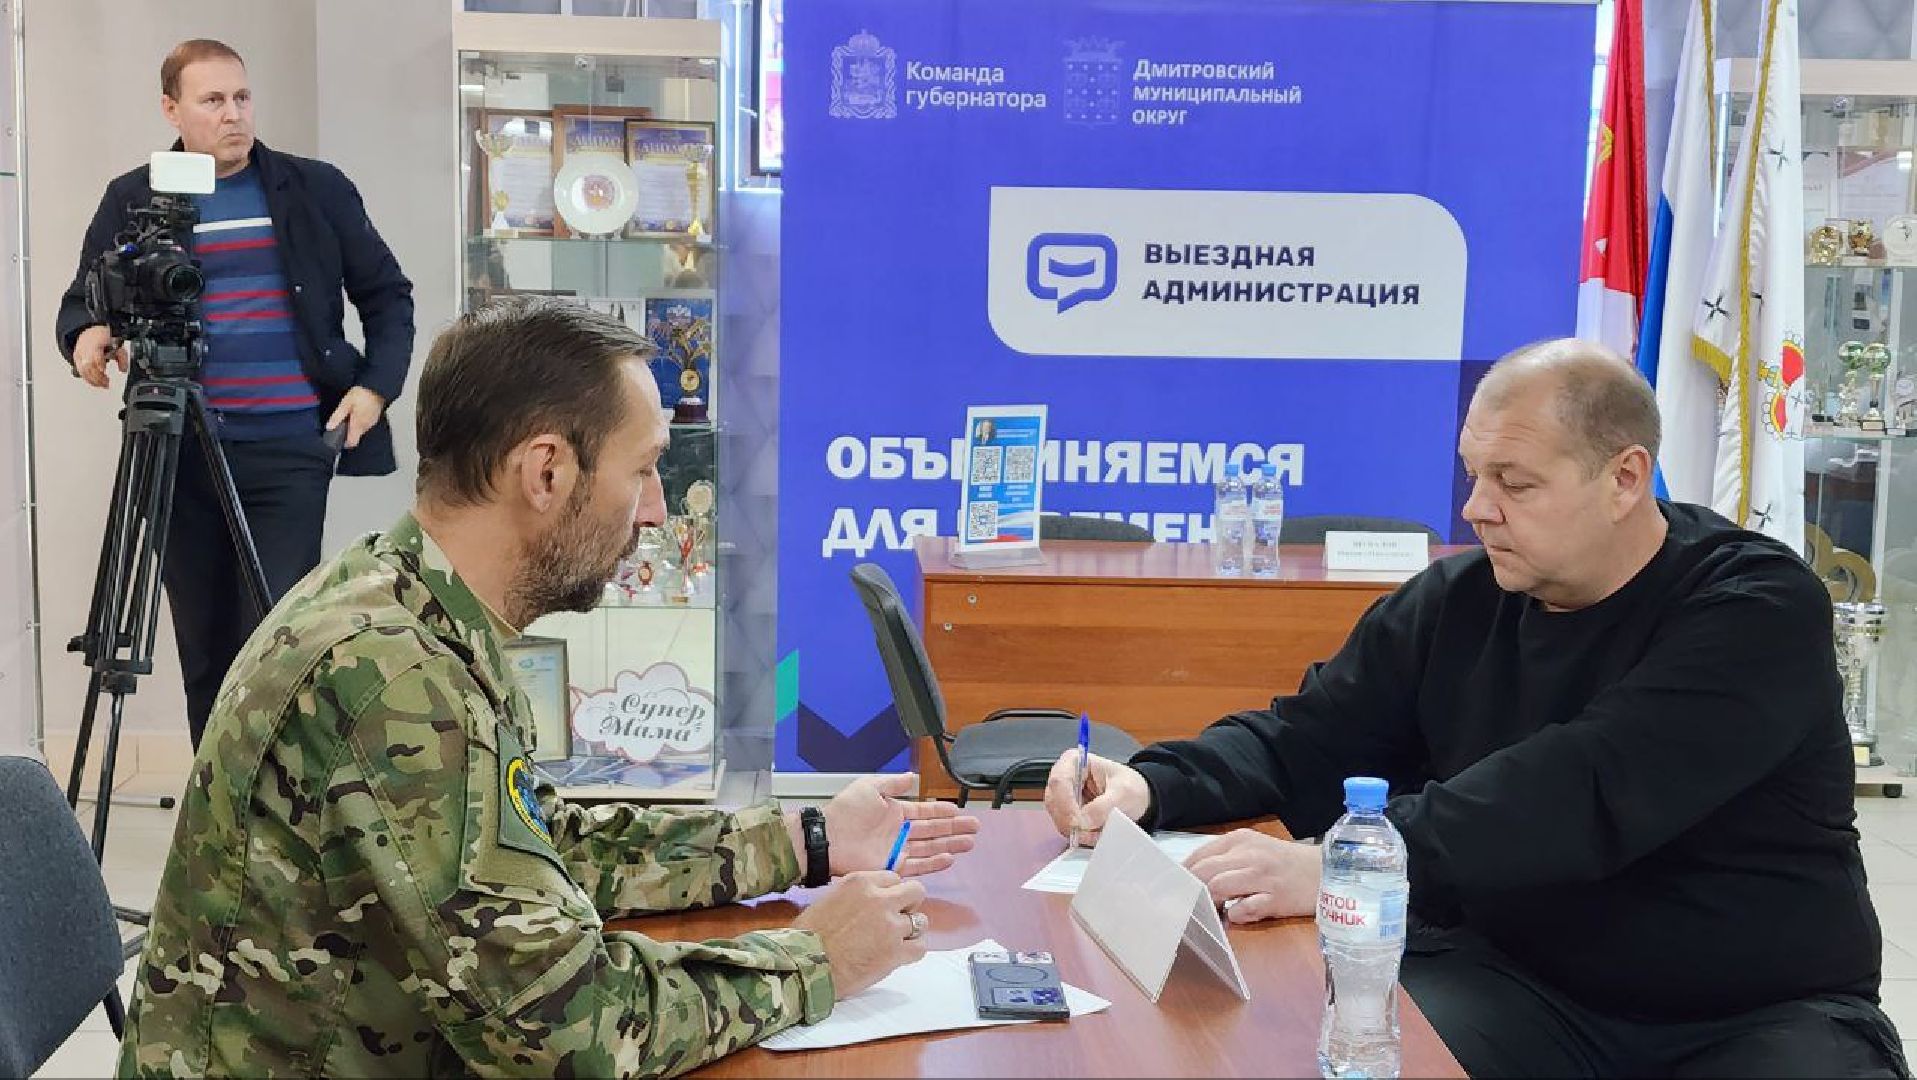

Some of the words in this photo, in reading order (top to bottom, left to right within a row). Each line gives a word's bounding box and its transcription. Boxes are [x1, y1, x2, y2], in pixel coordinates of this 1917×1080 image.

[906, 60, 1005, 86] Команда
[906, 86, 1047, 113] губернатора
[1133, 86, 1302, 104] МУНИЦИПАЛЬНЫЙ
[1132, 109, 1188, 125] ОКРУГ
[1144, 243, 1315, 269] ВЫЕЗДНАЯ
[1142, 279, 1420, 308] АДМИНИСТРАЦИЯ
[822, 508, 938, 558] ДЛЯ
[621, 693, 706, 726] Супер
[599, 715, 691, 742] Мама
